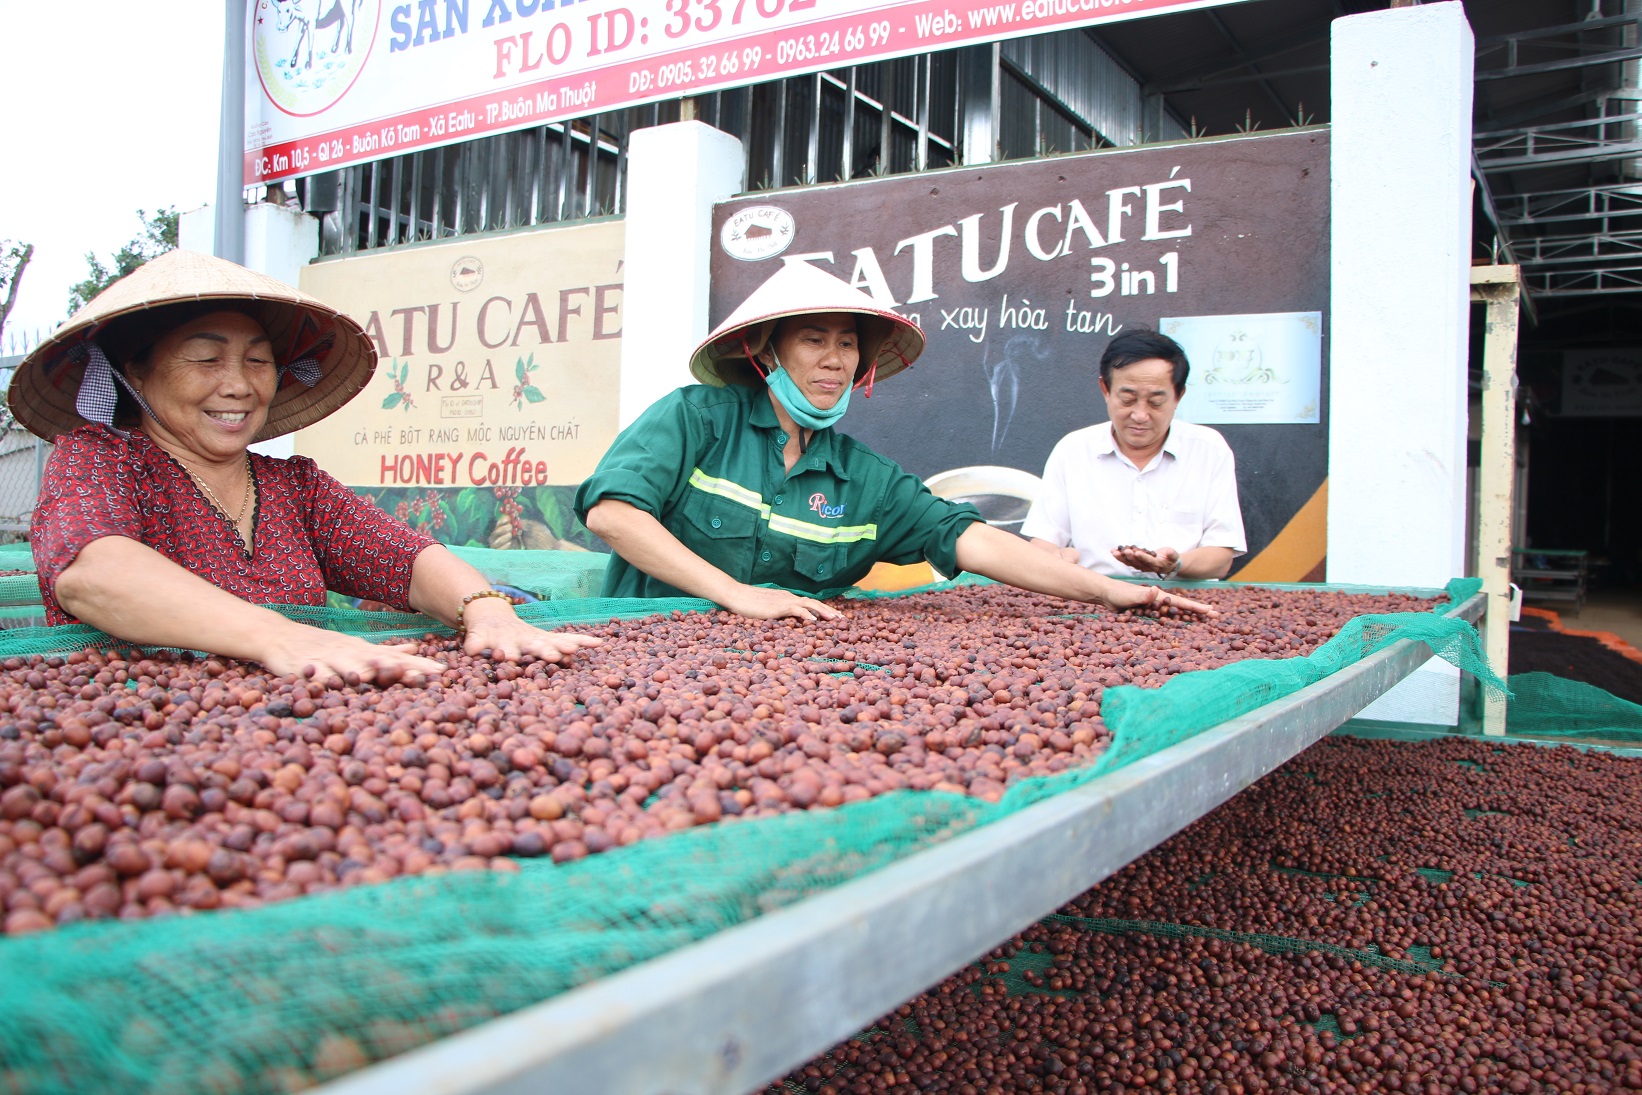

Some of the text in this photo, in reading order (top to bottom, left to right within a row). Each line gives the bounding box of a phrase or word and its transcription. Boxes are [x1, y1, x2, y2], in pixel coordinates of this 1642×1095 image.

[493, 22, 573, 79] FLO
[587, 8, 649, 58] ID:
[273, 154, 289, 173] Km
[291, 146, 310, 170] 10,5
[331, 138, 344, 159] 26
[353, 131, 379, 154] Buôn
[397, 124, 420, 144] Tam
[448, 109, 475, 133] Eatu
[536, 91, 557, 113] Ma
[560, 81, 597, 107] Thuột
[699, 54, 716, 79] 32
[720, 50, 739, 74] 66
[743, 46, 762, 70] 99
[777, 34, 840, 64] 0963.24
[845, 25, 865, 51] 66
[869, 20, 891, 46] 99
[915, 13, 962, 38] Web:
[734, 212, 754, 227] EATU
[1024, 166, 1192, 262] CAFÉ
[1091, 252, 1178, 298] 3 in 1
[477, 260, 624, 349] CAFÉ
[940, 307, 987, 343] xay
[999, 294, 1048, 330] hòa
[1066, 299, 1123, 336] tan
[354, 416, 581, 447] CÀ PHÊ BỘT RANG MỘC NGUYÊN CHẤT
[380, 446, 549, 486] HONEY Coffee
